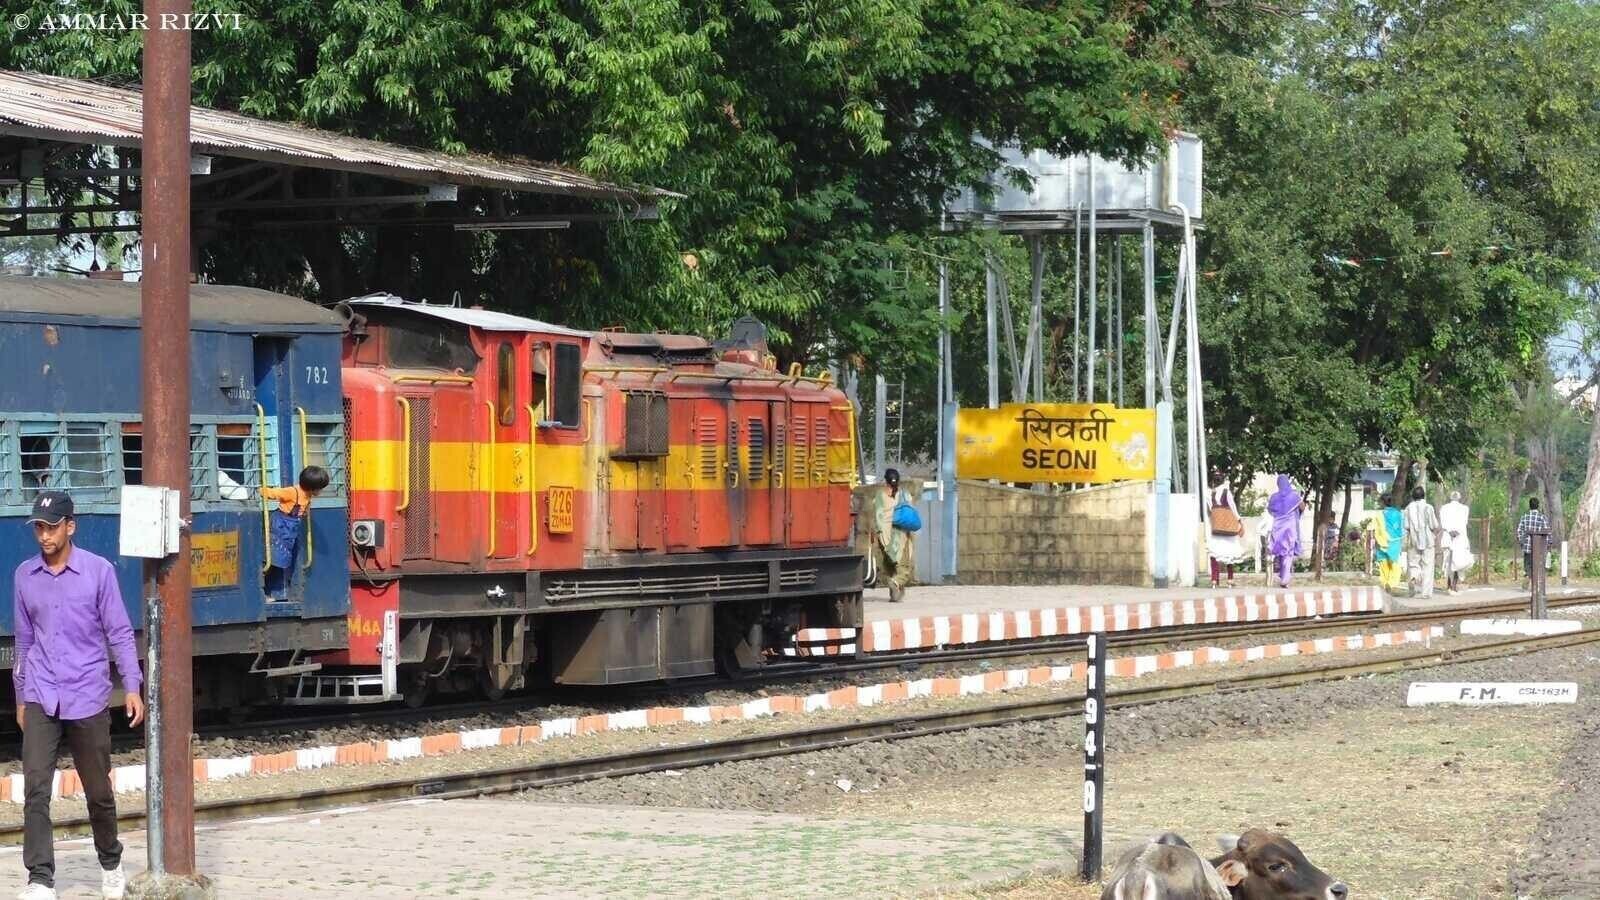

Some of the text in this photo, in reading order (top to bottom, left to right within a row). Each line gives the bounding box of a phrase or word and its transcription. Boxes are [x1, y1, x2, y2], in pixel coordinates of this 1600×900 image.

[305, 366, 329, 384] 782
[1015, 408, 1116, 446] सिवनी
[1022, 448, 1097, 470] SEONI
[552, 490, 572, 513] 226
